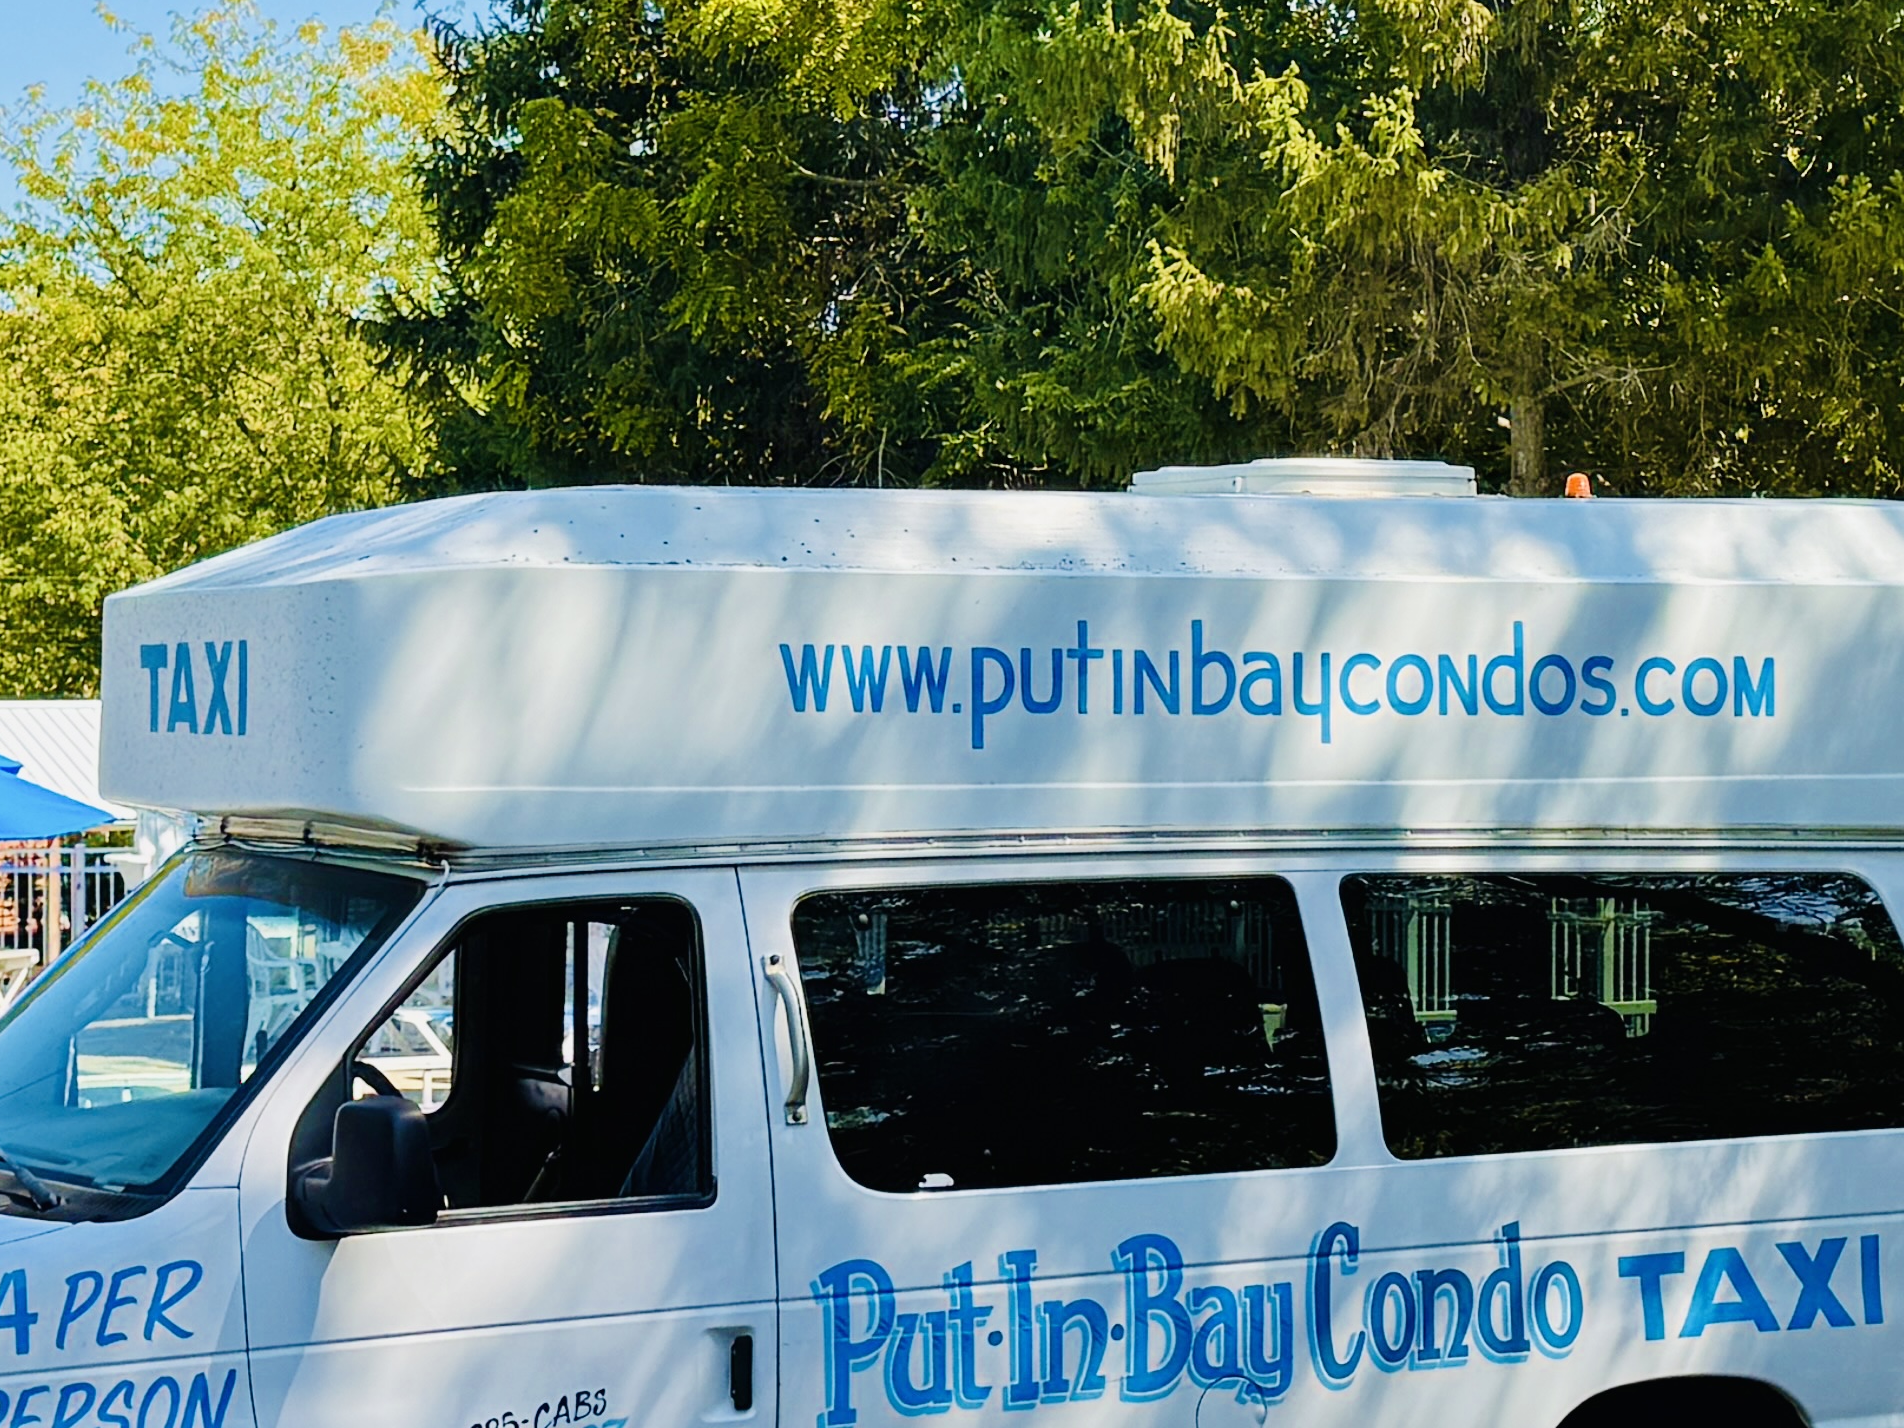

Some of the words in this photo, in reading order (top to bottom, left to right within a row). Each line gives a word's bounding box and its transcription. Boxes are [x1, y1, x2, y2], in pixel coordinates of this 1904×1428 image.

[140, 639, 248, 737] TAXI
[55, 1259, 204, 1352] PER
[1306, 1220, 1584, 1392] Condo
[1617, 1233, 1885, 1342] TAXI
